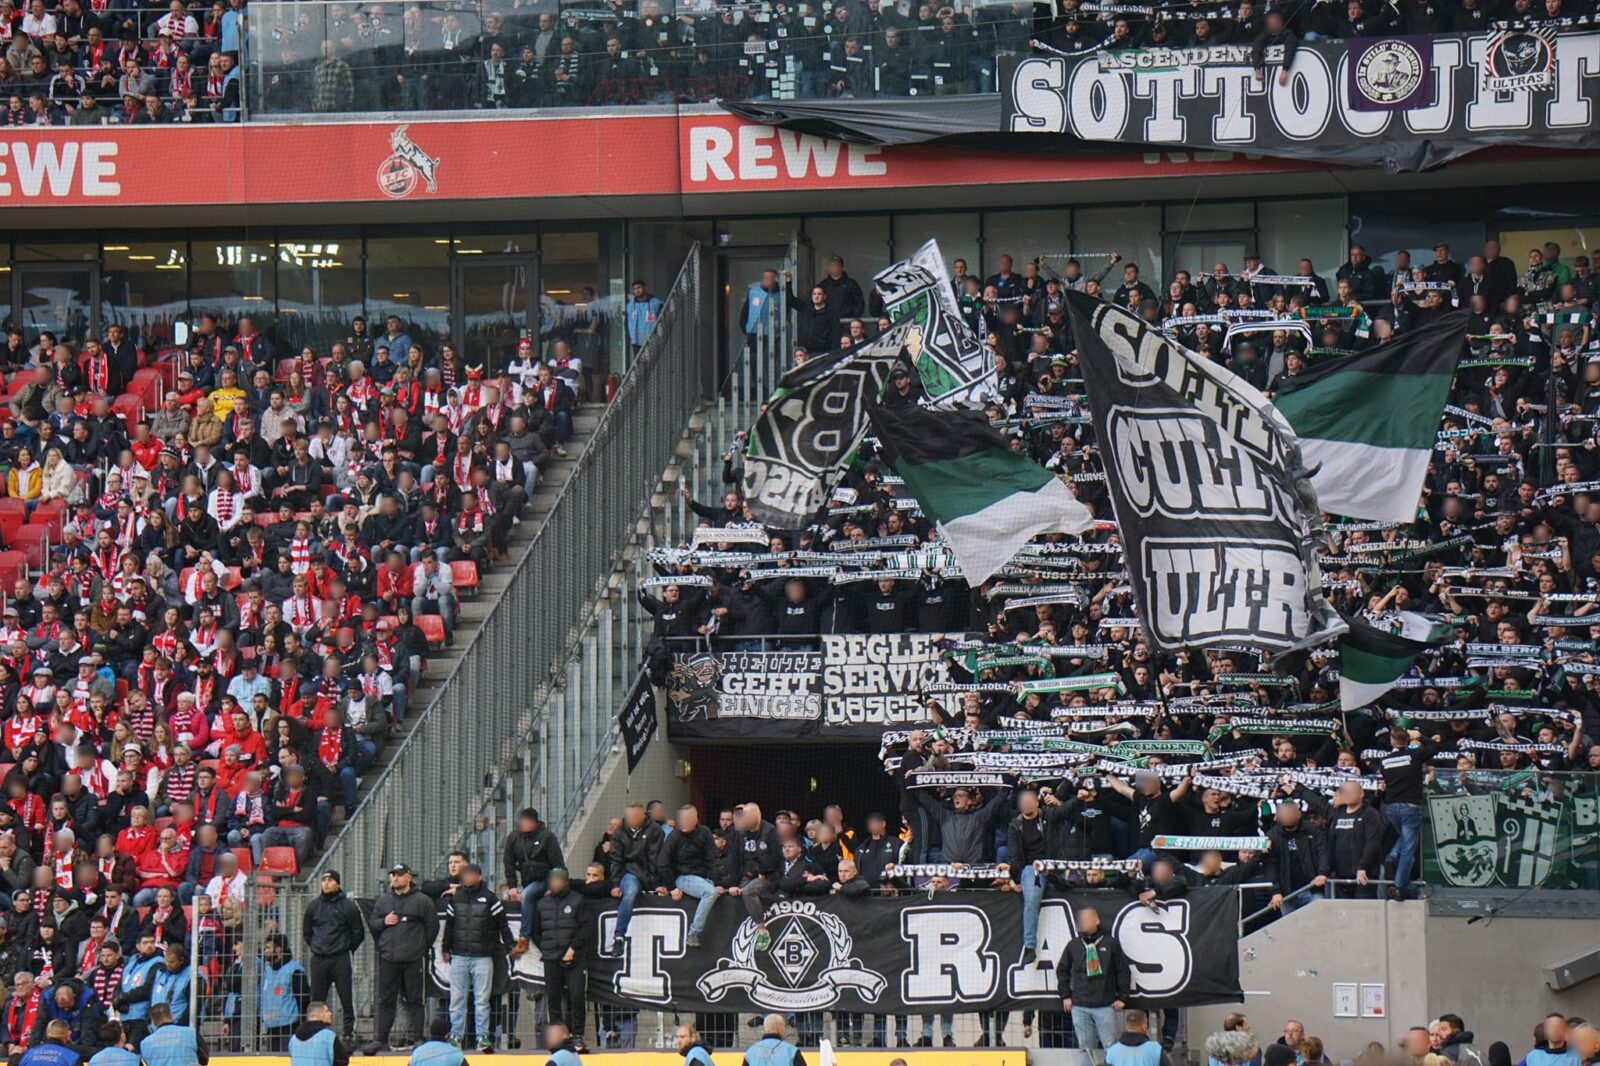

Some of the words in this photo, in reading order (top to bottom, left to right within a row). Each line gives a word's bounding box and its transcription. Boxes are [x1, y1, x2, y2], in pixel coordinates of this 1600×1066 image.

[1099, 44, 1285, 70] ASCENDENE
[1493, 74, 1545, 90] ULTRAS
[690, 125, 887, 182] REWE
[0, 142, 121, 196] WE
[750, 566, 837, 579] BEGLEITSERVICE
[835, 568, 921, 583] BEGLEITSERVICE
[722, 652, 822, 673] HEUTE
[722, 672, 816, 696] GEHT
[718, 693, 822, 721] EINIGES
[1051, 704, 1155, 718] ÖNCHENGLADBAC
[916, 774, 1003, 785] SOTTOCULTURA
[771, 900, 816, 916] 1900
[784, 939, 805, 968] B
[32, 1055, 58, 1063] SERVICE
